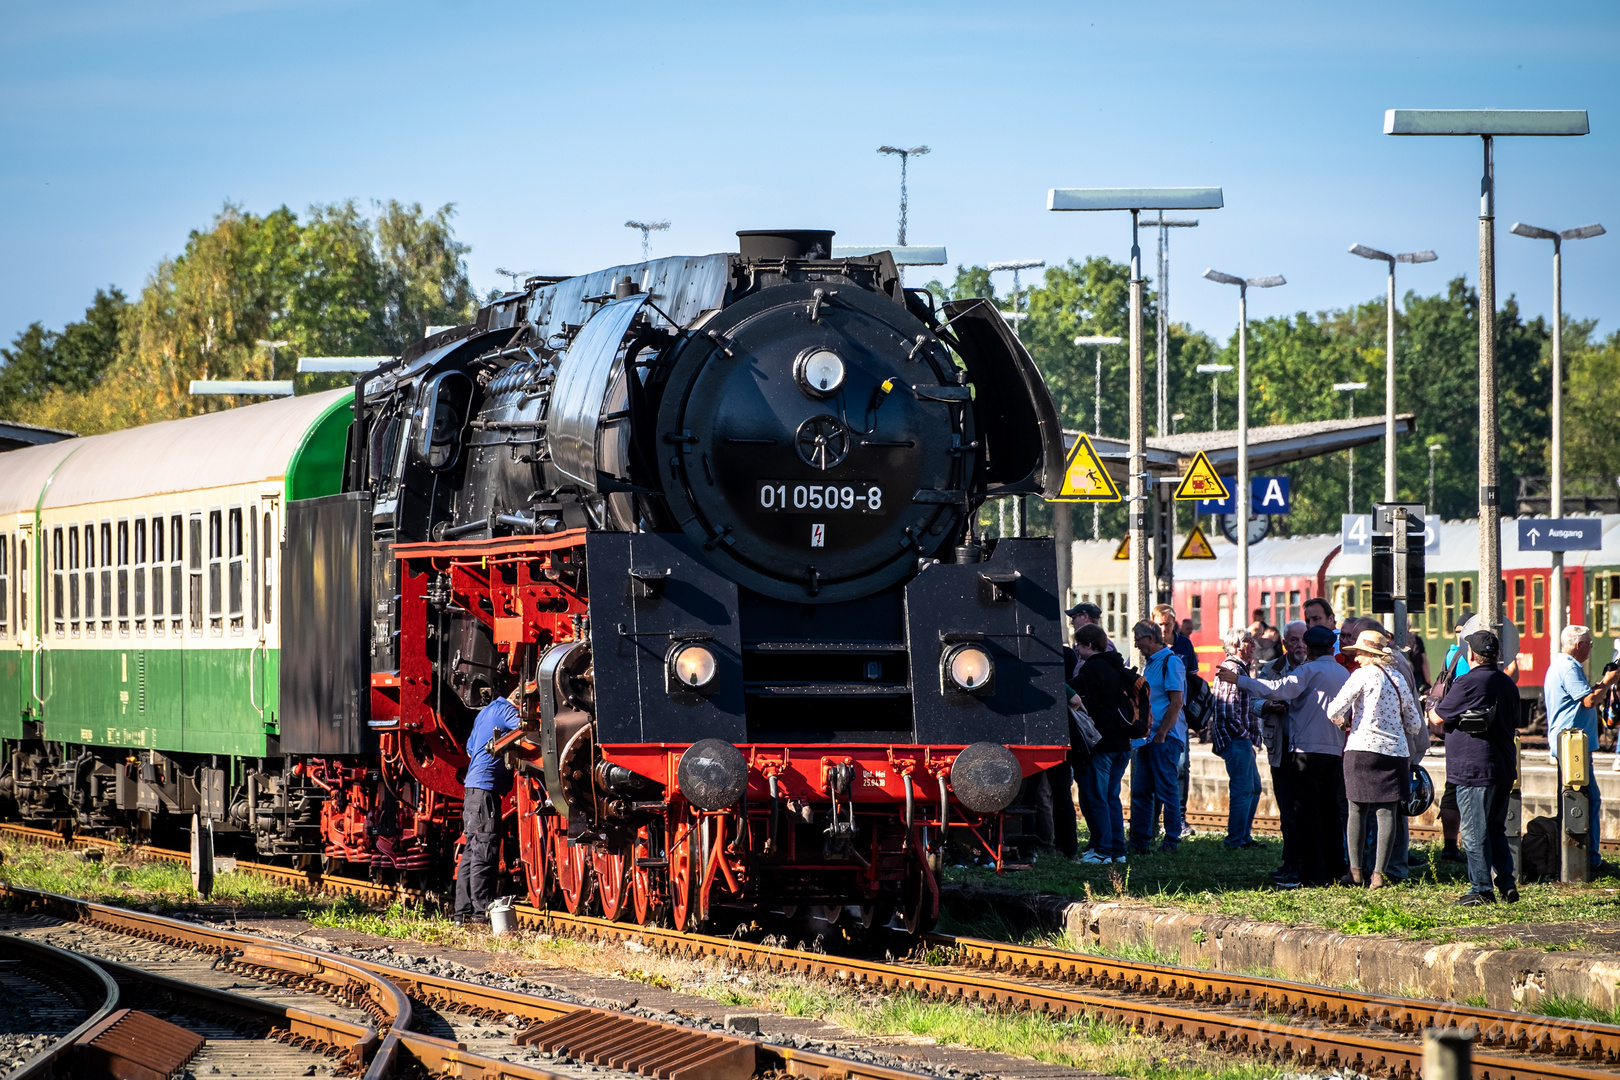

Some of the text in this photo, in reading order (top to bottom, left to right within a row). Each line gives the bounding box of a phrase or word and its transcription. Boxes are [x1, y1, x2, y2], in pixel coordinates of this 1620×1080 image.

[760, 485, 882, 510] 01 0509-8
[1262, 479, 1285, 506] A
[1488, 491, 1495, 500] H
[1348, 515, 1368, 546] 4
[1548, 528, 1583, 539] Ausgang
